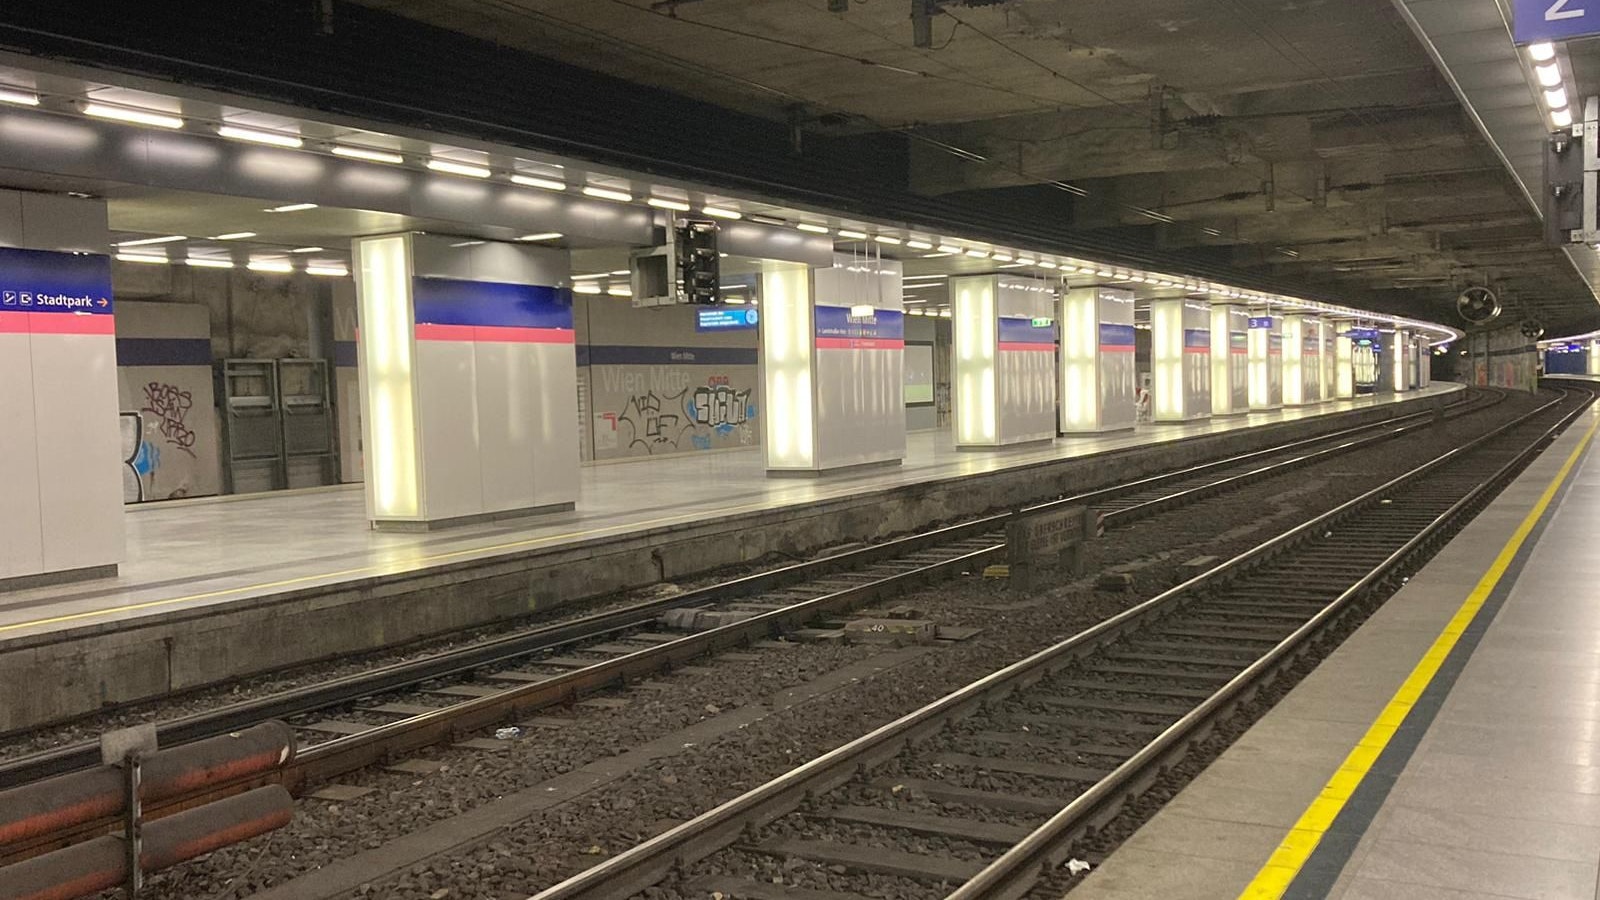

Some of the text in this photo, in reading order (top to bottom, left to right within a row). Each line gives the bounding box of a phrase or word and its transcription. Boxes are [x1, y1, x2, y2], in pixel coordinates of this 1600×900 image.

[36, 293, 93, 308] Stadtpark
[601, 364, 690, 393] Wien Mitte
[871, 624, 885, 633] 40
